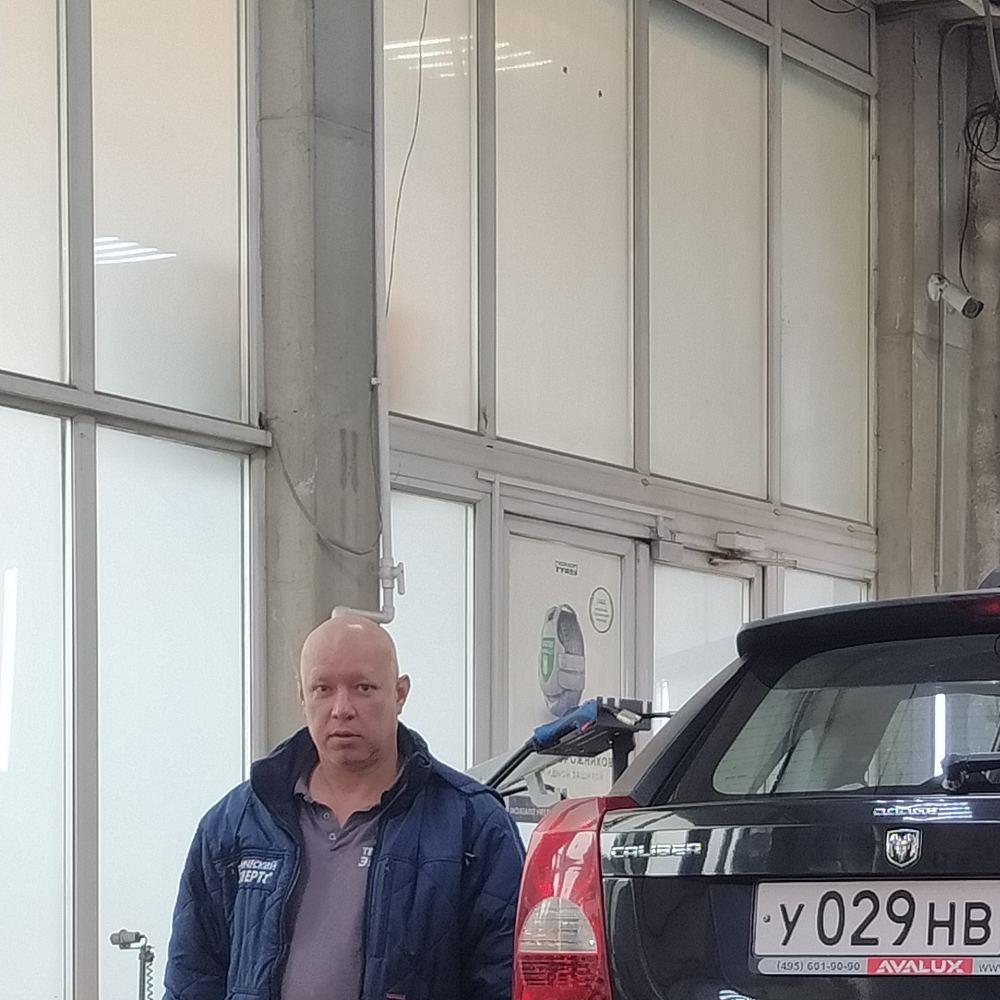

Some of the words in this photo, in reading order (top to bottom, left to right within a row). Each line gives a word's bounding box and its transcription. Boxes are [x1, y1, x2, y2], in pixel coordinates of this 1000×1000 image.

[611, 842, 702, 858] CALIBER
[777, 960, 804, 972] (495)
[876, 959, 964, 973] AVALUX
